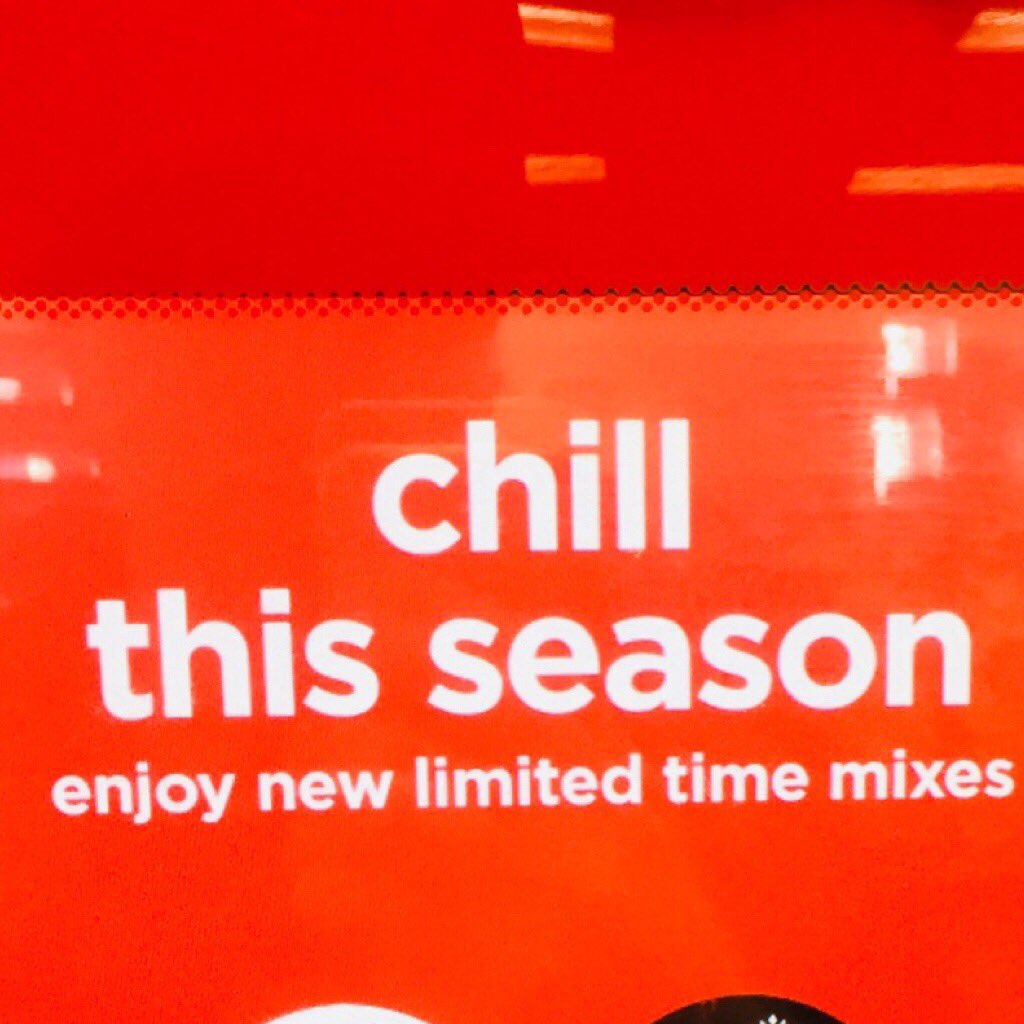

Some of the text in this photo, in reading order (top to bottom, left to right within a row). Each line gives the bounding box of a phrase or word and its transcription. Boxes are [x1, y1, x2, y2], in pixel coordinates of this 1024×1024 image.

[371, 417, 691, 555] chill
[86, 587, 972, 721] this season
[51, 748, 1015, 825] enjoy new limited time mixes
